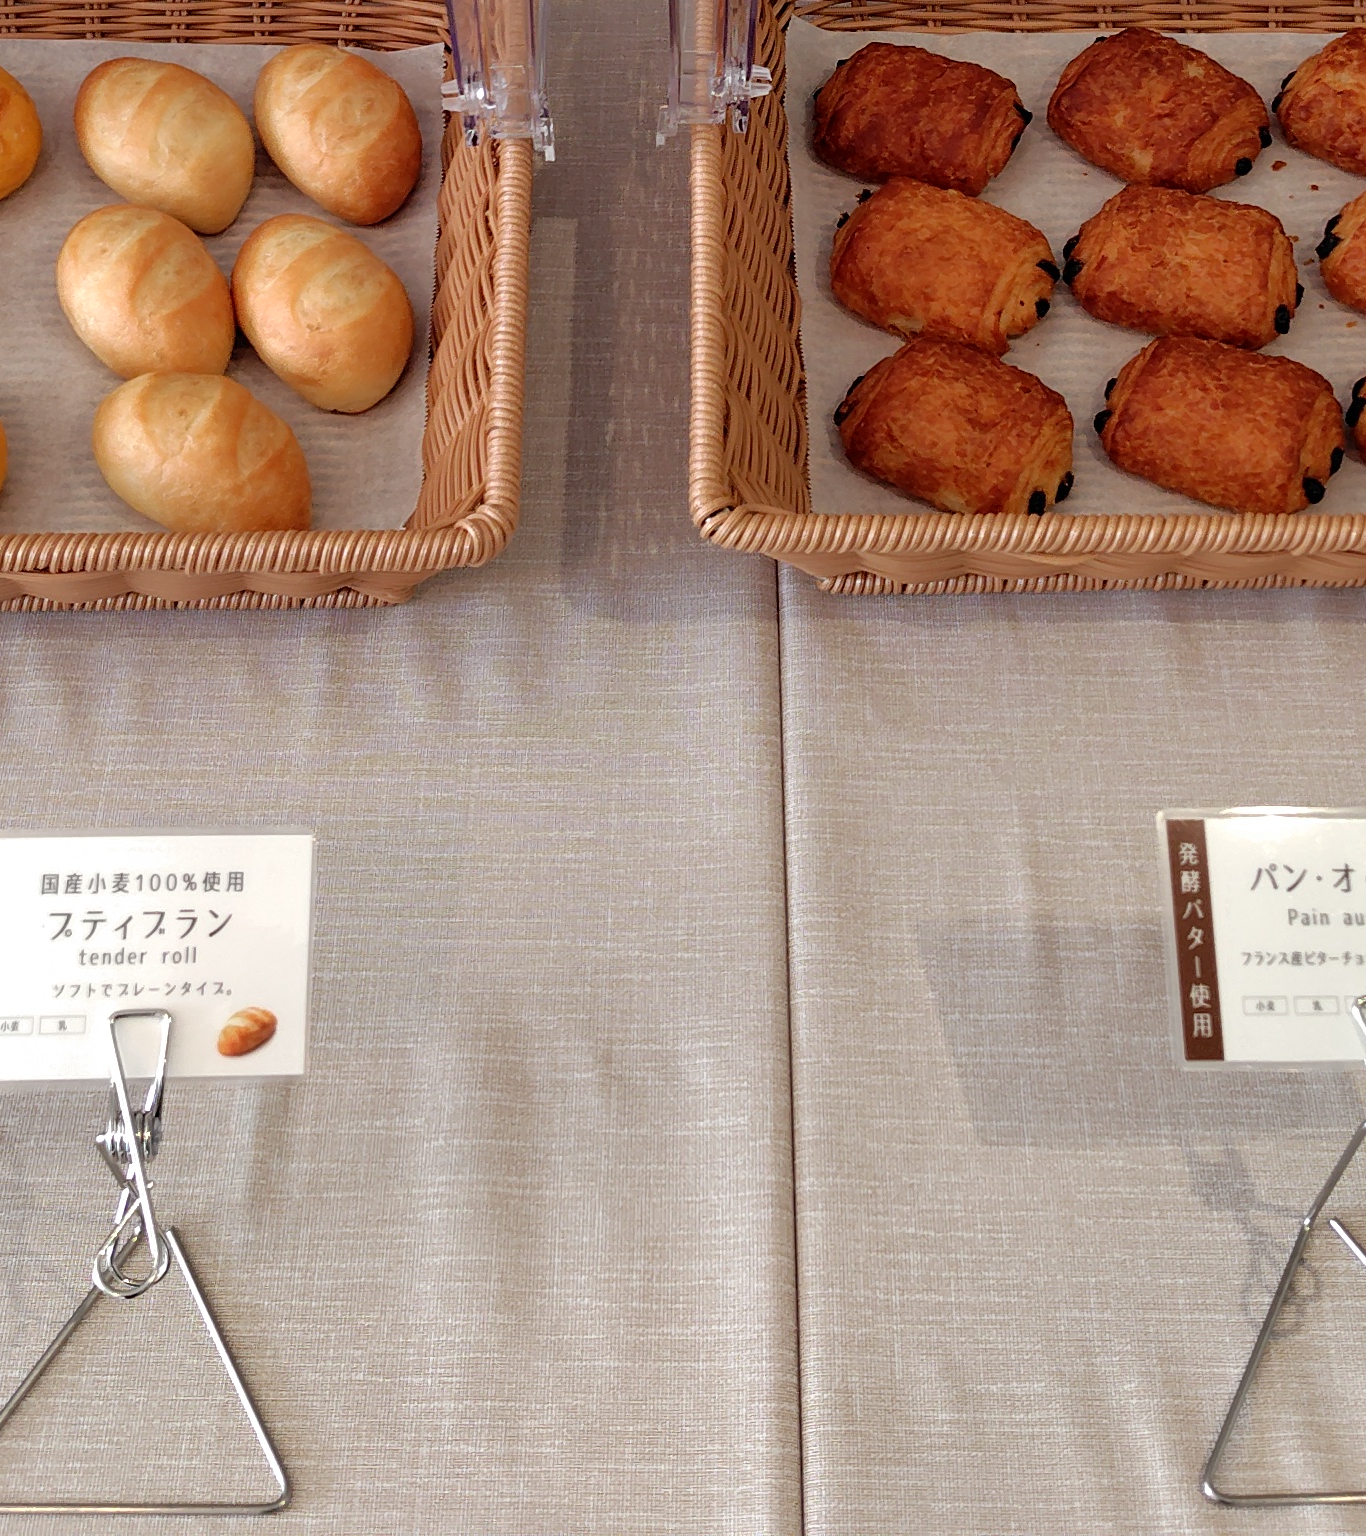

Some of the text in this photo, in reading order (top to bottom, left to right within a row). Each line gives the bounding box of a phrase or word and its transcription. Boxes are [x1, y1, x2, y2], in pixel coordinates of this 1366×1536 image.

[41, 871, 245, 895] 国産小麦100%使用
[48, 909, 233, 940] プティブラン
[1288, 908, 1330, 926] Pain
[1344, 912, 1365, 926] au
[1179, 842, 1213, 1039] 発酵バター使用
[79, 947, 197, 966] tender roll
